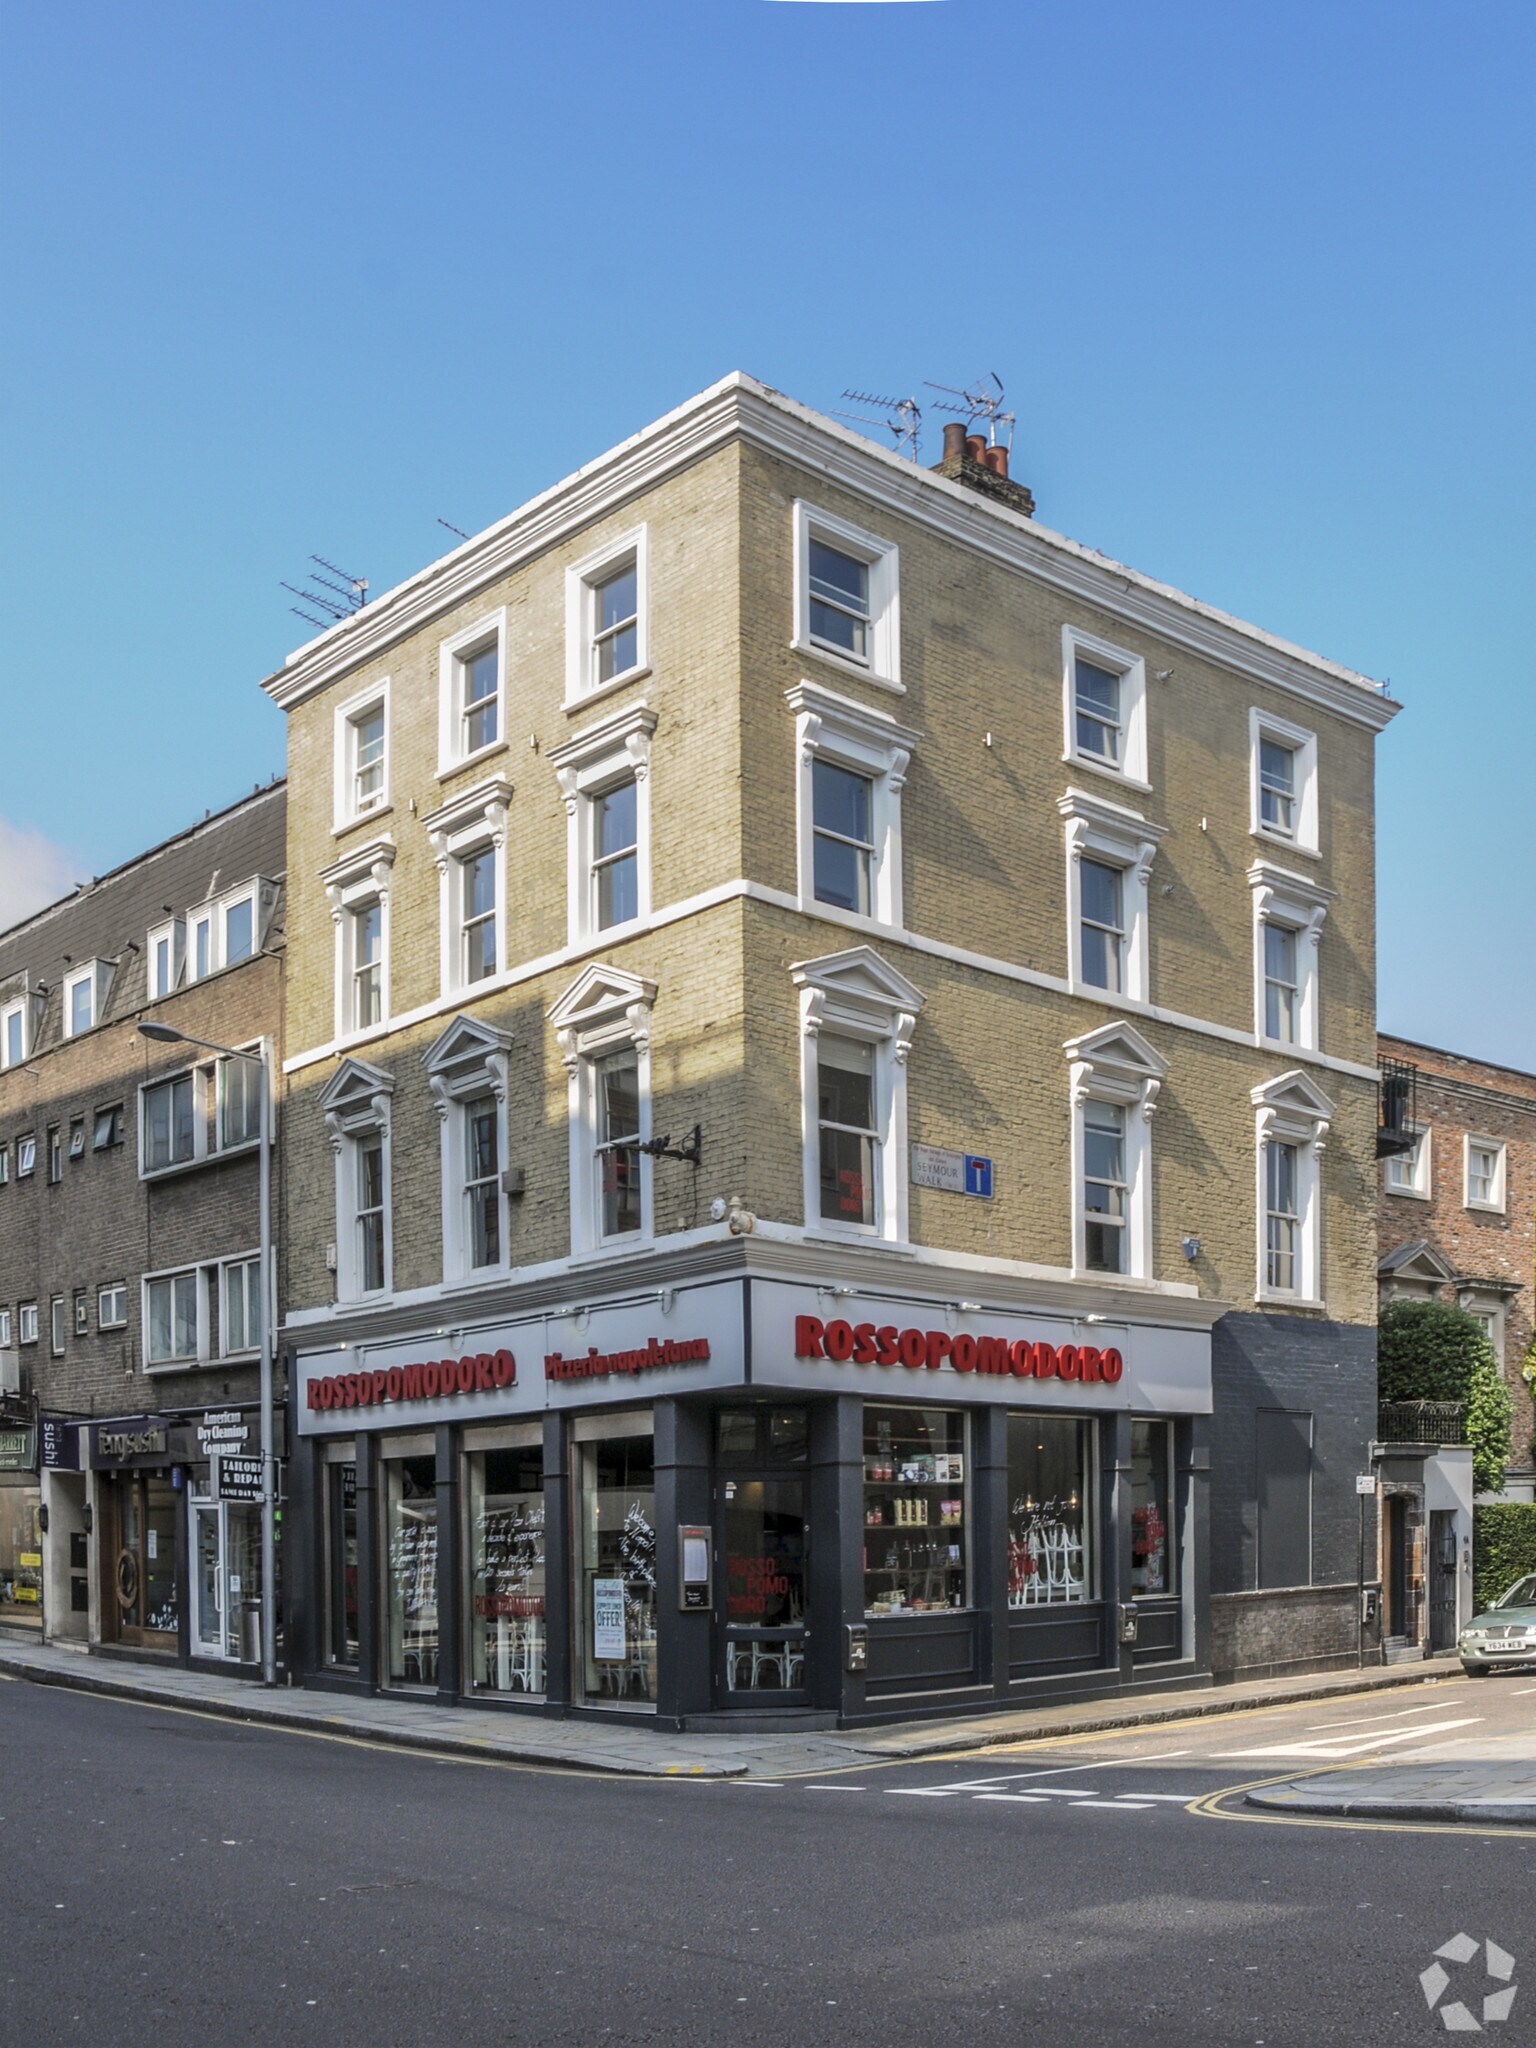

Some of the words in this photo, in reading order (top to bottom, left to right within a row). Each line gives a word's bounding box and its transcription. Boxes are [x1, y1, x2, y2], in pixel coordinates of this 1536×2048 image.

[917, 1162, 958, 1178] SEYMOUR
[918, 1173, 942, 1186] WALK
[795, 1315, 1122, 1383] ROSSOPOMODORO
[544, 1347, 609, 1380] Pizzeria
[608, 1337, 711, 1376] napoletana
[307, 1349, 516, 1410] ROSSOPOMODORO
[204, 1411, 241, 1425] American
[197, 1426, 212, 1440] Dry
[212, 1425, 248, 1439] Cleaning
[43, 1423, 59, 1465] sushi
[202, 1441, 241, 1455] Company
[223, 1460, 261, 1473] TAILORI
[223, 1473, 231, 1483] &
[233, 1473, 262, 1485] REPAI
[596, 1610, 622, 1627] OFFER!
